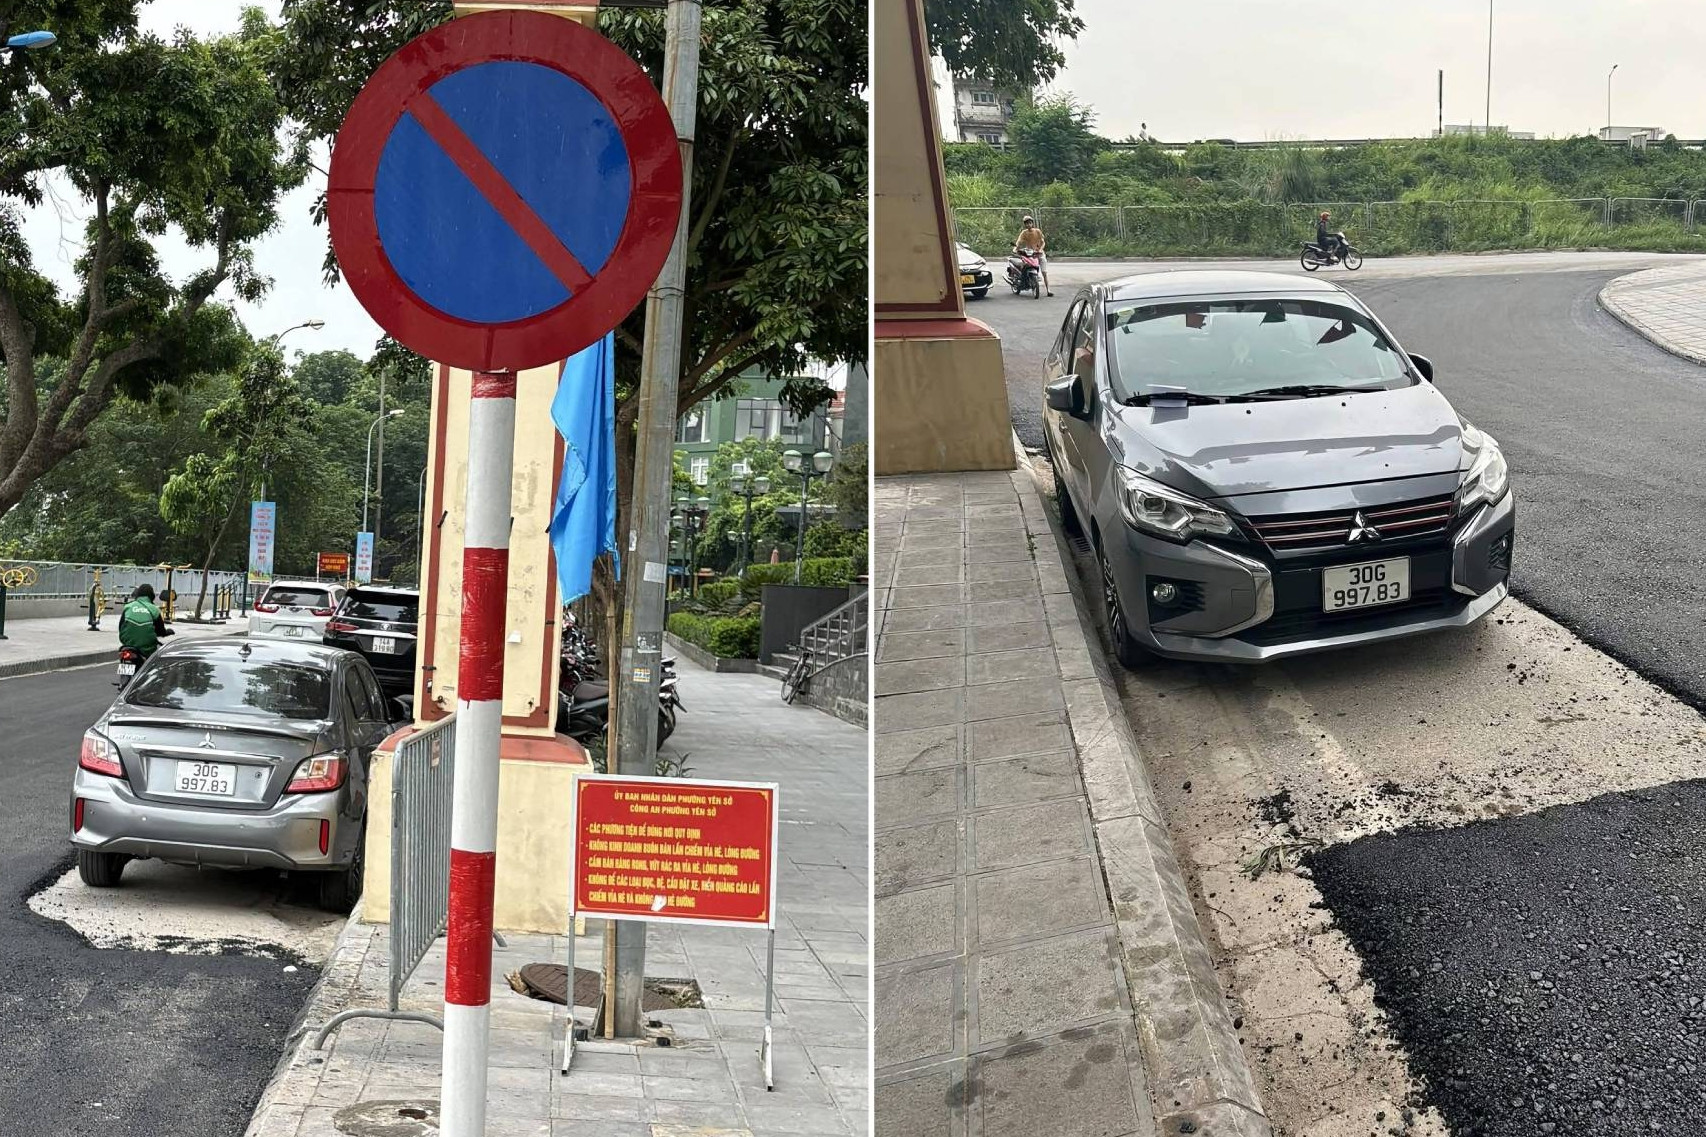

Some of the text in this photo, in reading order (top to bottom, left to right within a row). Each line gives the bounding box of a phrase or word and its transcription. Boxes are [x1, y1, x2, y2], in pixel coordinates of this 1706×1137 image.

[1349, 564, 1386, 585] 30G
[1334, 582, 1400, 608] 997.83
[193, 764, 218, 778] 30G
[182, 777, 228, 793] 997.83
[625, 792, 639, 800] BAN
[641, 792, 660, 802] NHÂN
[662, 793, 676, 802] DÂN
[678, 794, 706, 804] PHƯỜNG
[708, 795, 721, 805] YÊN
[630, 803, 648, 813] CÔNG
[651, 806, 660, 814] AN
[662, 805, 690, 815] PHƯỜNG
[692, 807, 705, 816] YÊN
[589, 822, 601, 834] CÁC
[602, 823, 624, 835] PHƯƠNG
[625, 823, 637, 837] TIỆN
[675, 827, 686, 839] QUY
[589, 839, 608, 851] KHÔNG
[609, 841, 622, 852] KINH
[624, 841, 642, 853] DOANH
[643, 841, 659, 854] BUÔN
[685, 843, 702, 857] CHIẾM
[589, 854, 601, 868] CẤM
[615, 857, 630, 869] HÀNG
[673, 861, 681, 873] RA
[588, 872, 607, 885] KHÔNG
[616, 874, 628, 886] CÁC
[629, 876, 641, 889] LOẠI
[716, 877, 735, 893] QUẢNG
[736, 880, 747, 893] CÁO
[589, 888, 606, 902] CHIẾM
